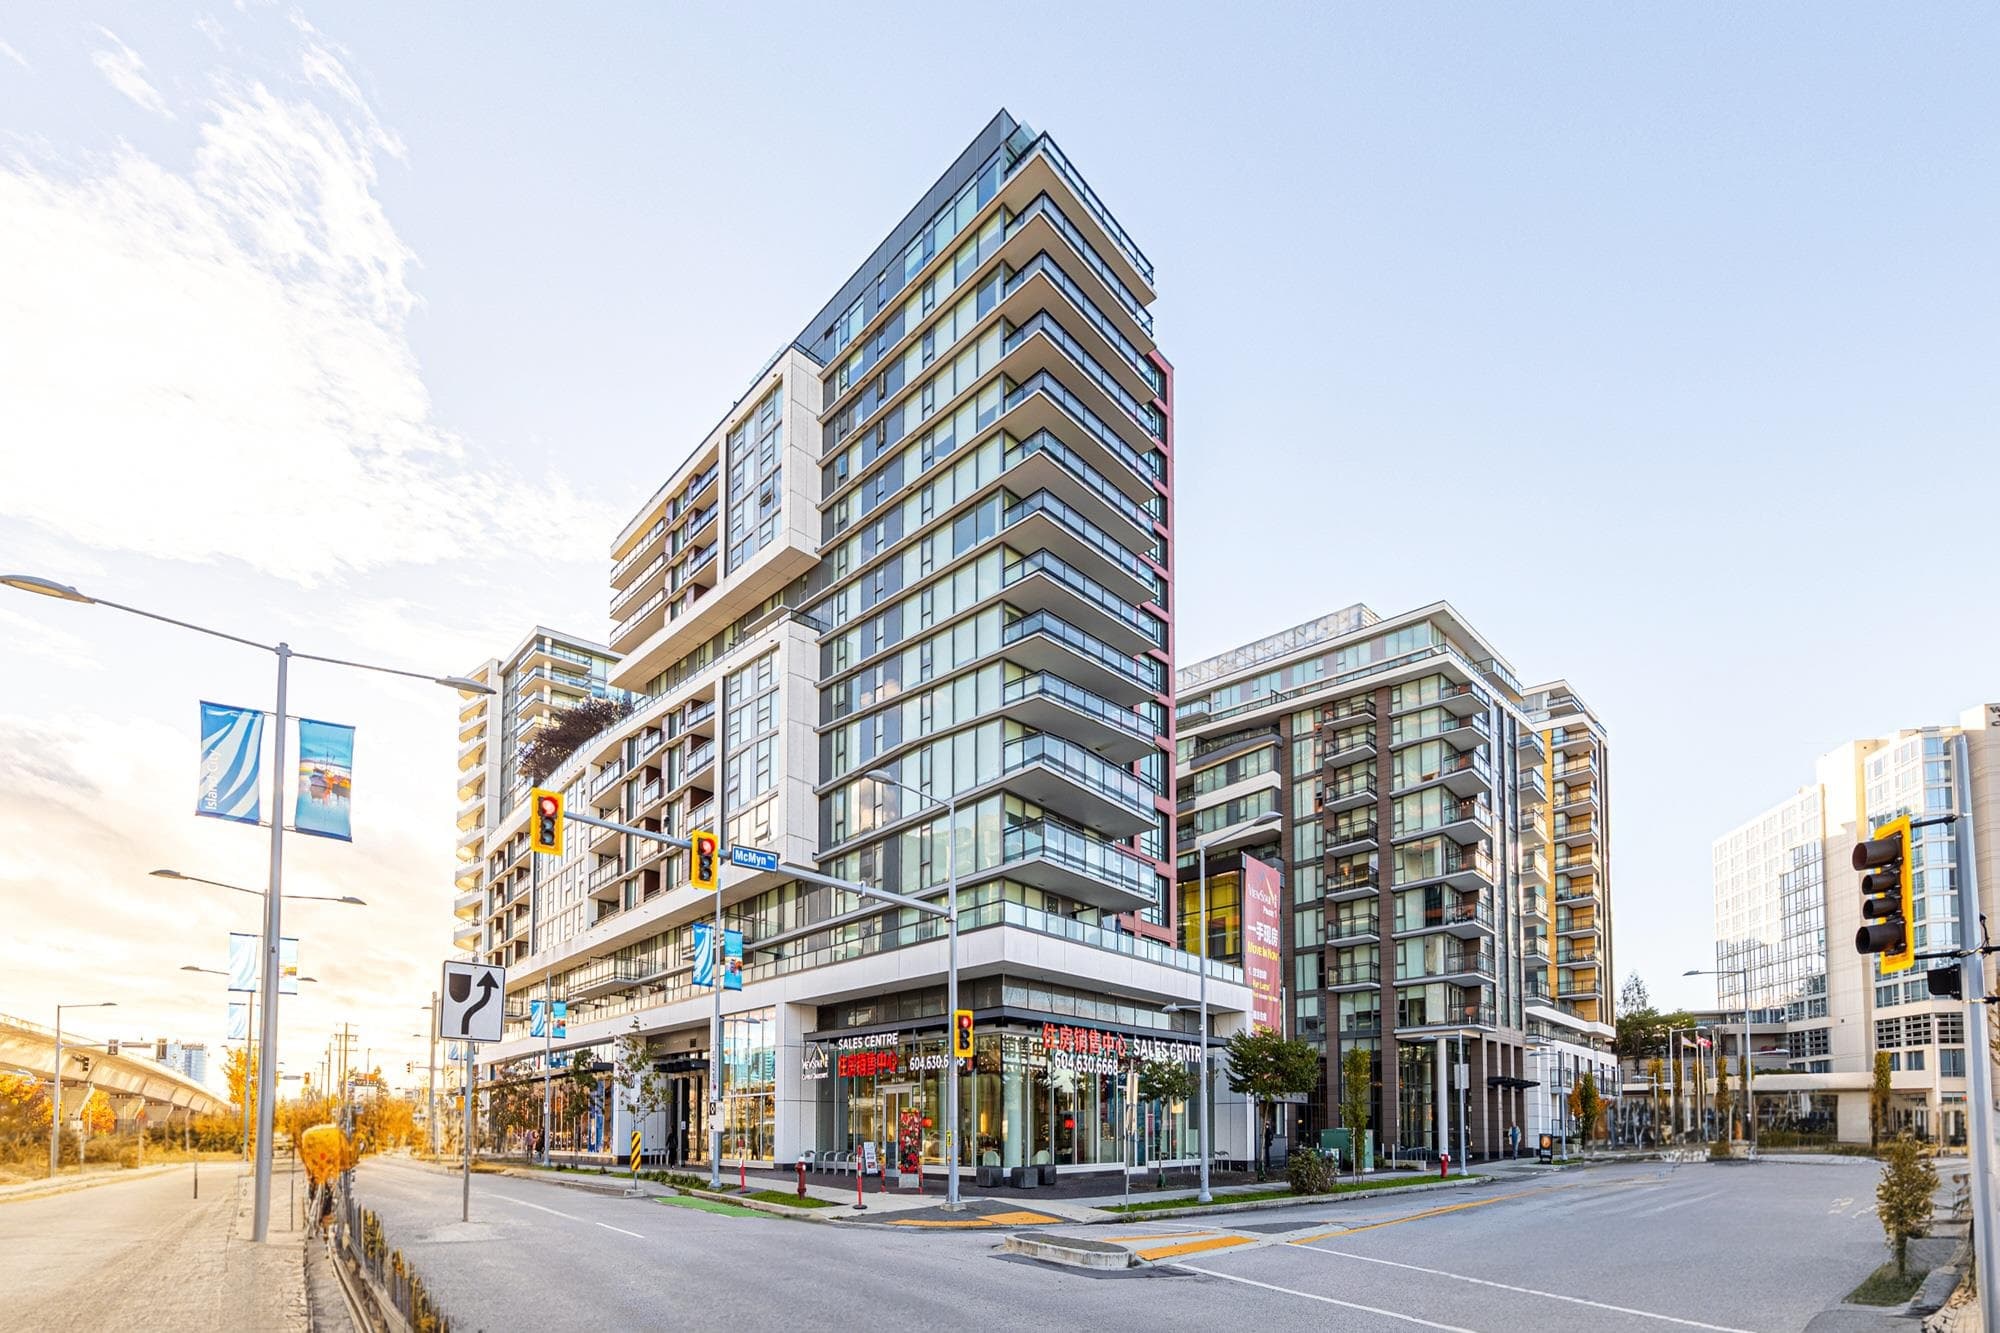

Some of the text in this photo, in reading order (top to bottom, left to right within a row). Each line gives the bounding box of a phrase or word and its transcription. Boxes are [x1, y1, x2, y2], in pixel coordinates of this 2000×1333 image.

[735, 849, 767, 866] McMyn
[838, 1032, 899, 1050] SALES CENTRE
[1042, 1022, 1128, 1057] 住房销售中心
[1133, 1038, 1202, 1063] SALES CENTR
[1054, 1051, 1119, 1076] 604.630.6668
